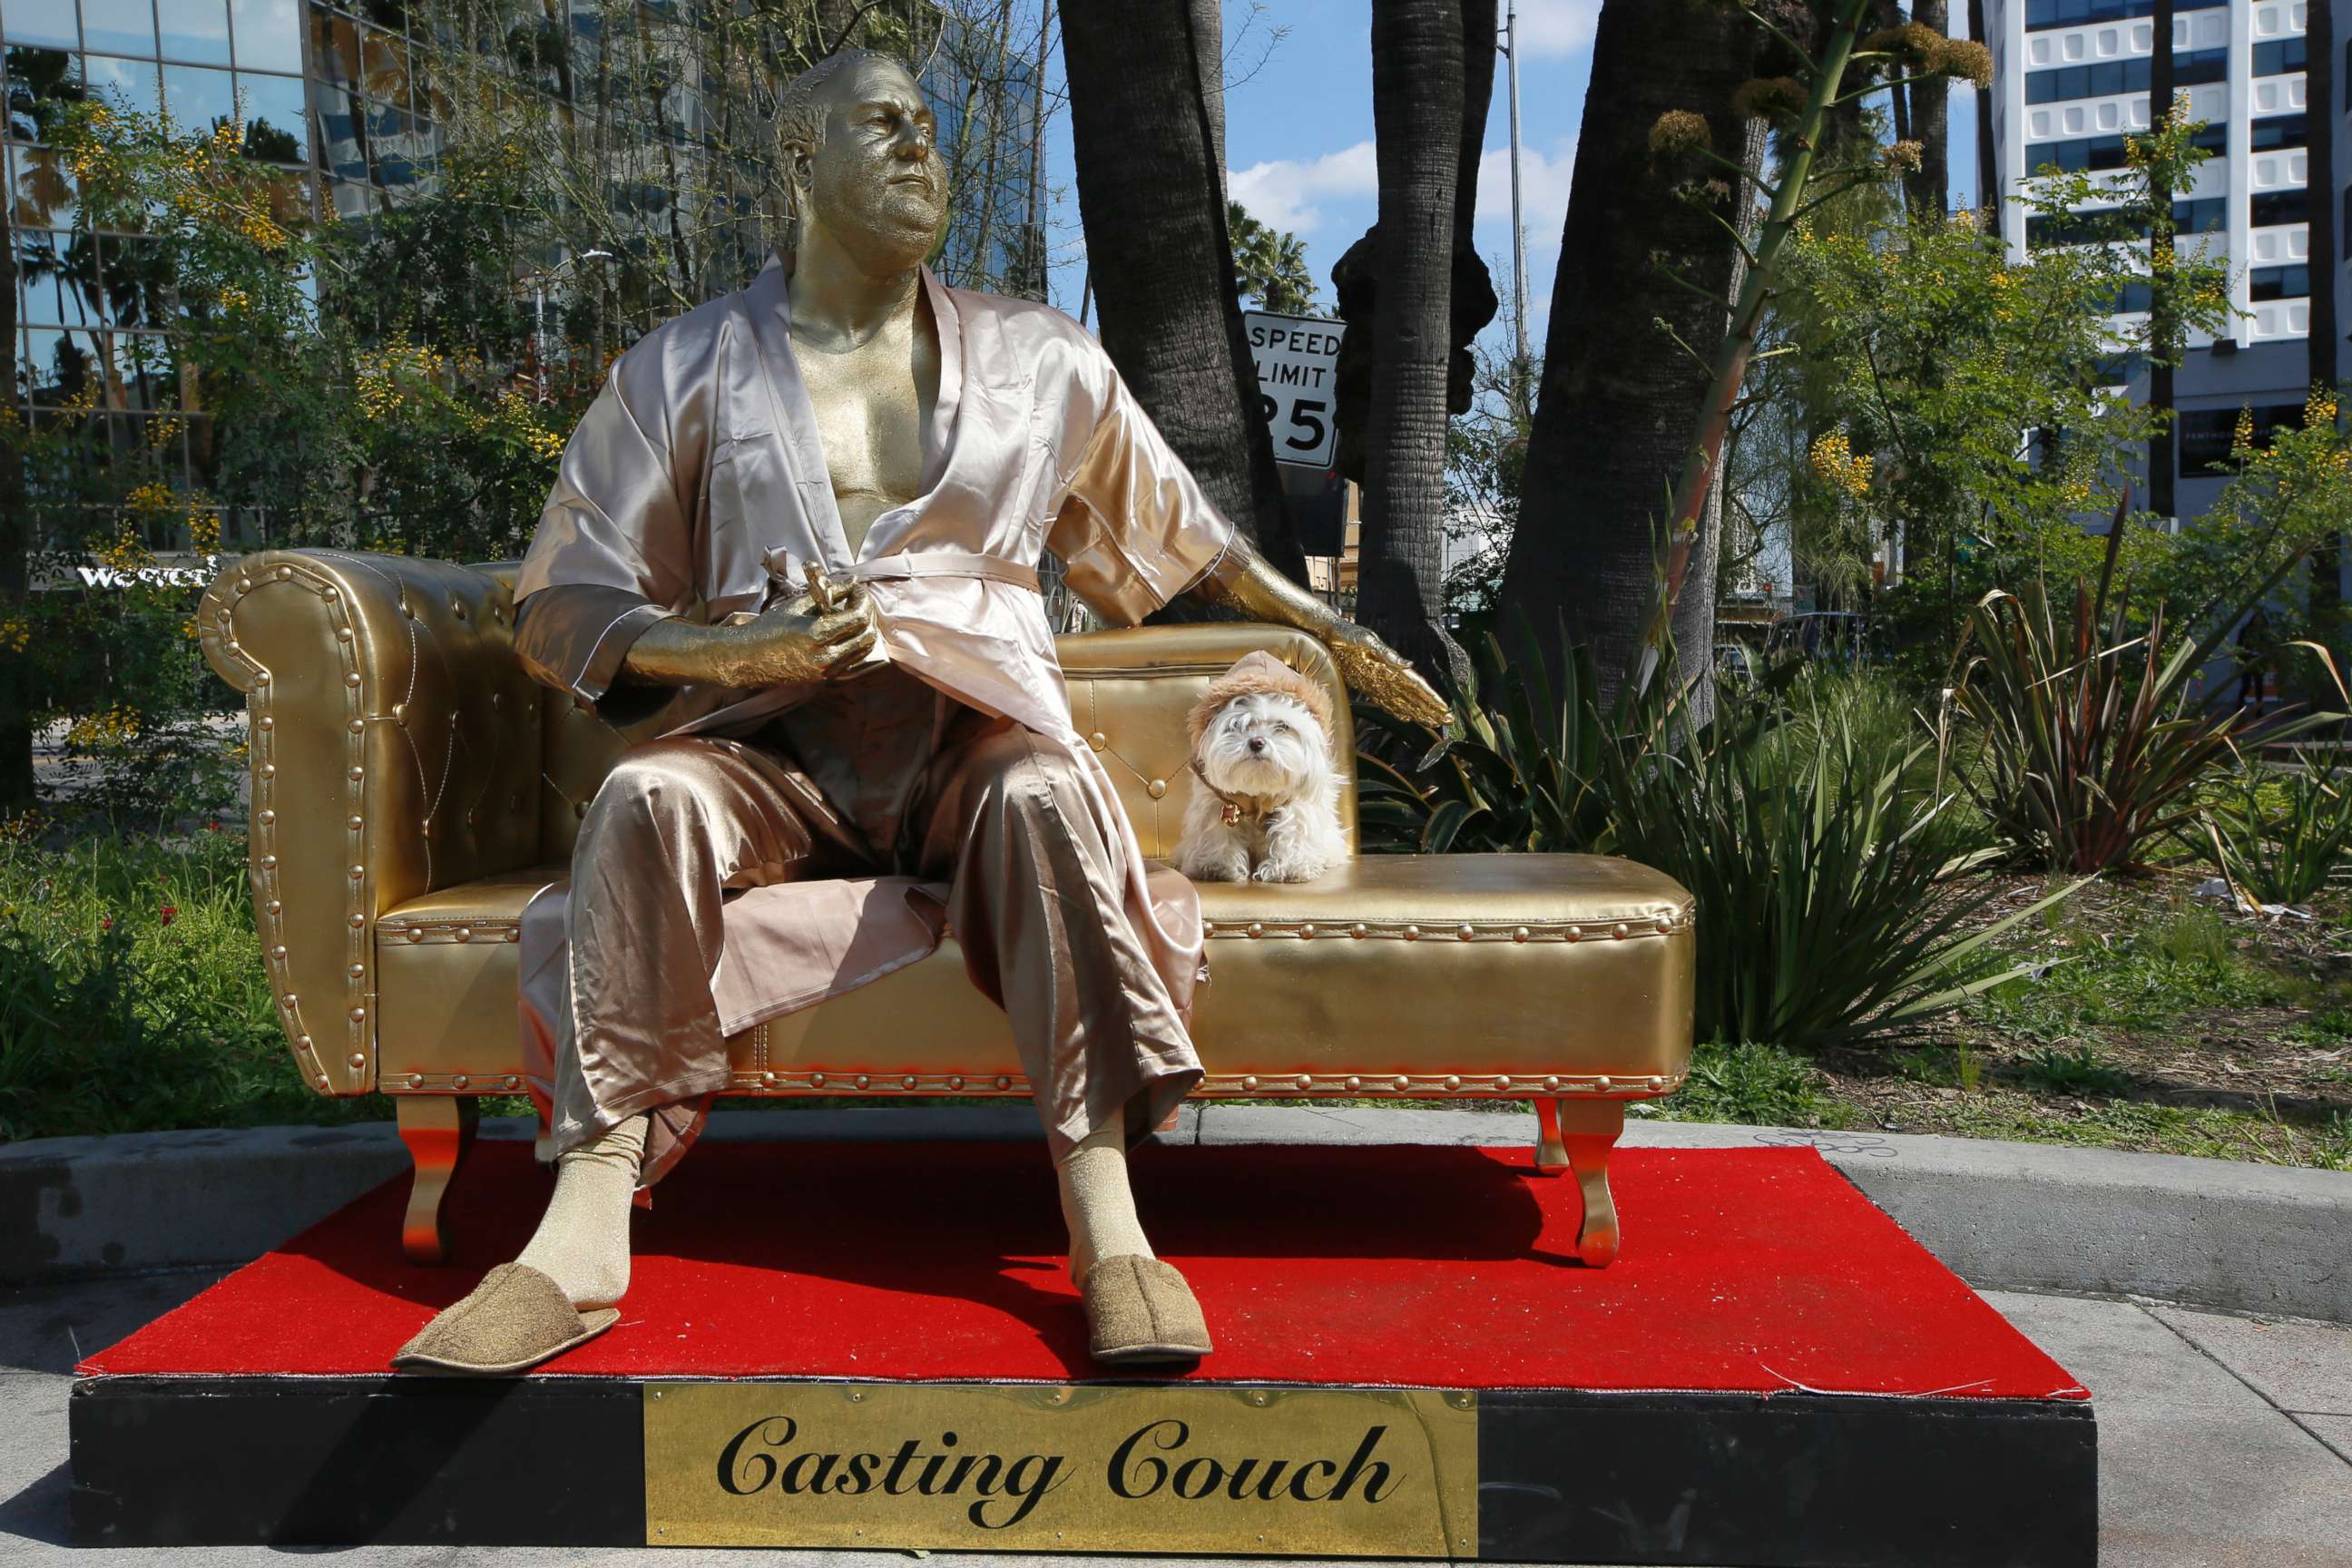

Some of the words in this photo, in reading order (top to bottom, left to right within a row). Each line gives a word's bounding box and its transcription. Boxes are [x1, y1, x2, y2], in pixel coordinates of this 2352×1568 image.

[1249, 327, 1342, 357] SPEED
[1256, 360, 1328, 388] LIMIT
[716, 1416, 1074, 1529] Casting
[1107, 1419, 1406, 1503] Couch
